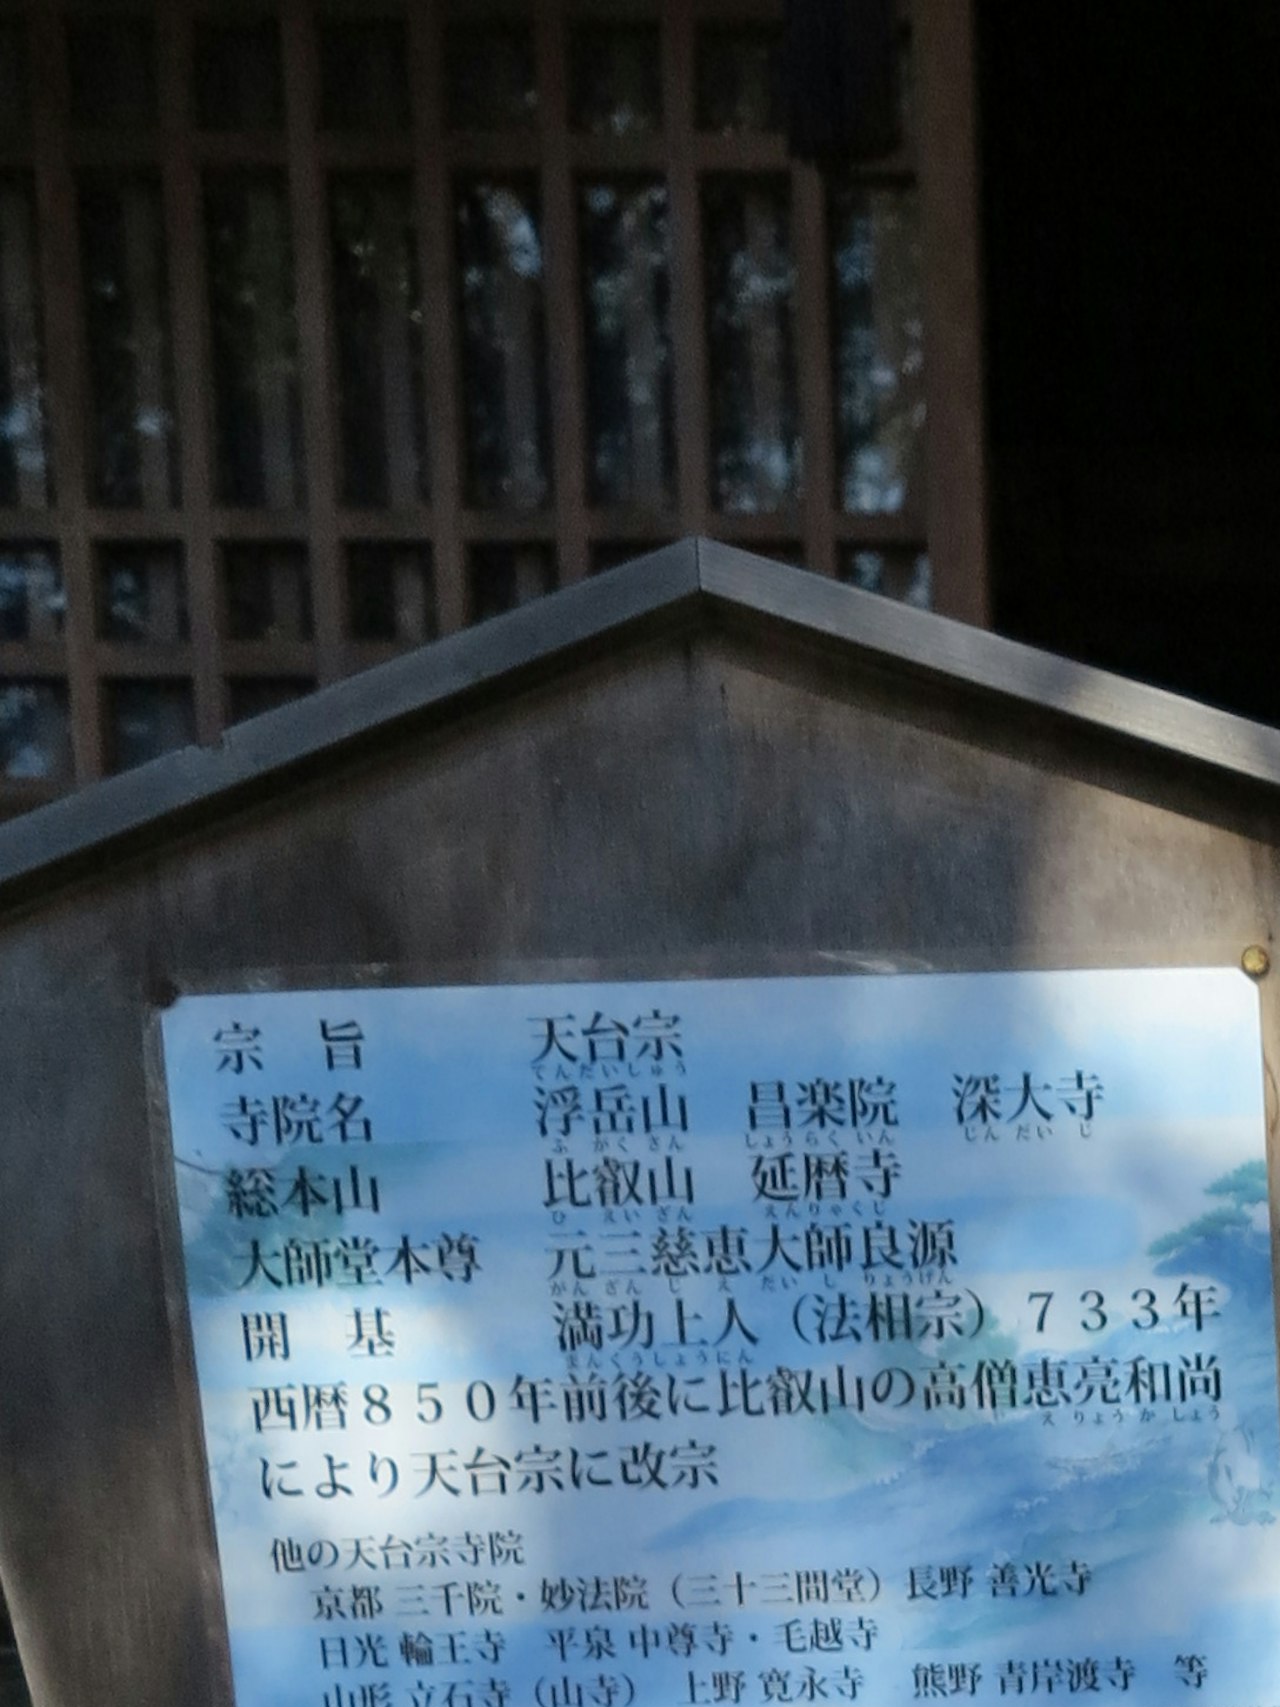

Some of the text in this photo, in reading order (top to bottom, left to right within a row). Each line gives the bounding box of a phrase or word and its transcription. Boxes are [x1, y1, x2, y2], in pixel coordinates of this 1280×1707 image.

[526, 1008, 684, 1064] 天台宗
[219, 1069, 1104, 1146] 寺院名 浮岳山 昌楽院 深大寺
[224, 1148, 902, 1219] 総本山 比叡山 延暦寺
[231, 1217, 958, 1290] 大師堂本尊 元三慈恵大師良源
[259, 1438, 720, 1501] により天台宗に改宗
[270, 1528, 526, 1575] 他の天台宗寺院
[1174, 1652, 1209, 1690] 等
